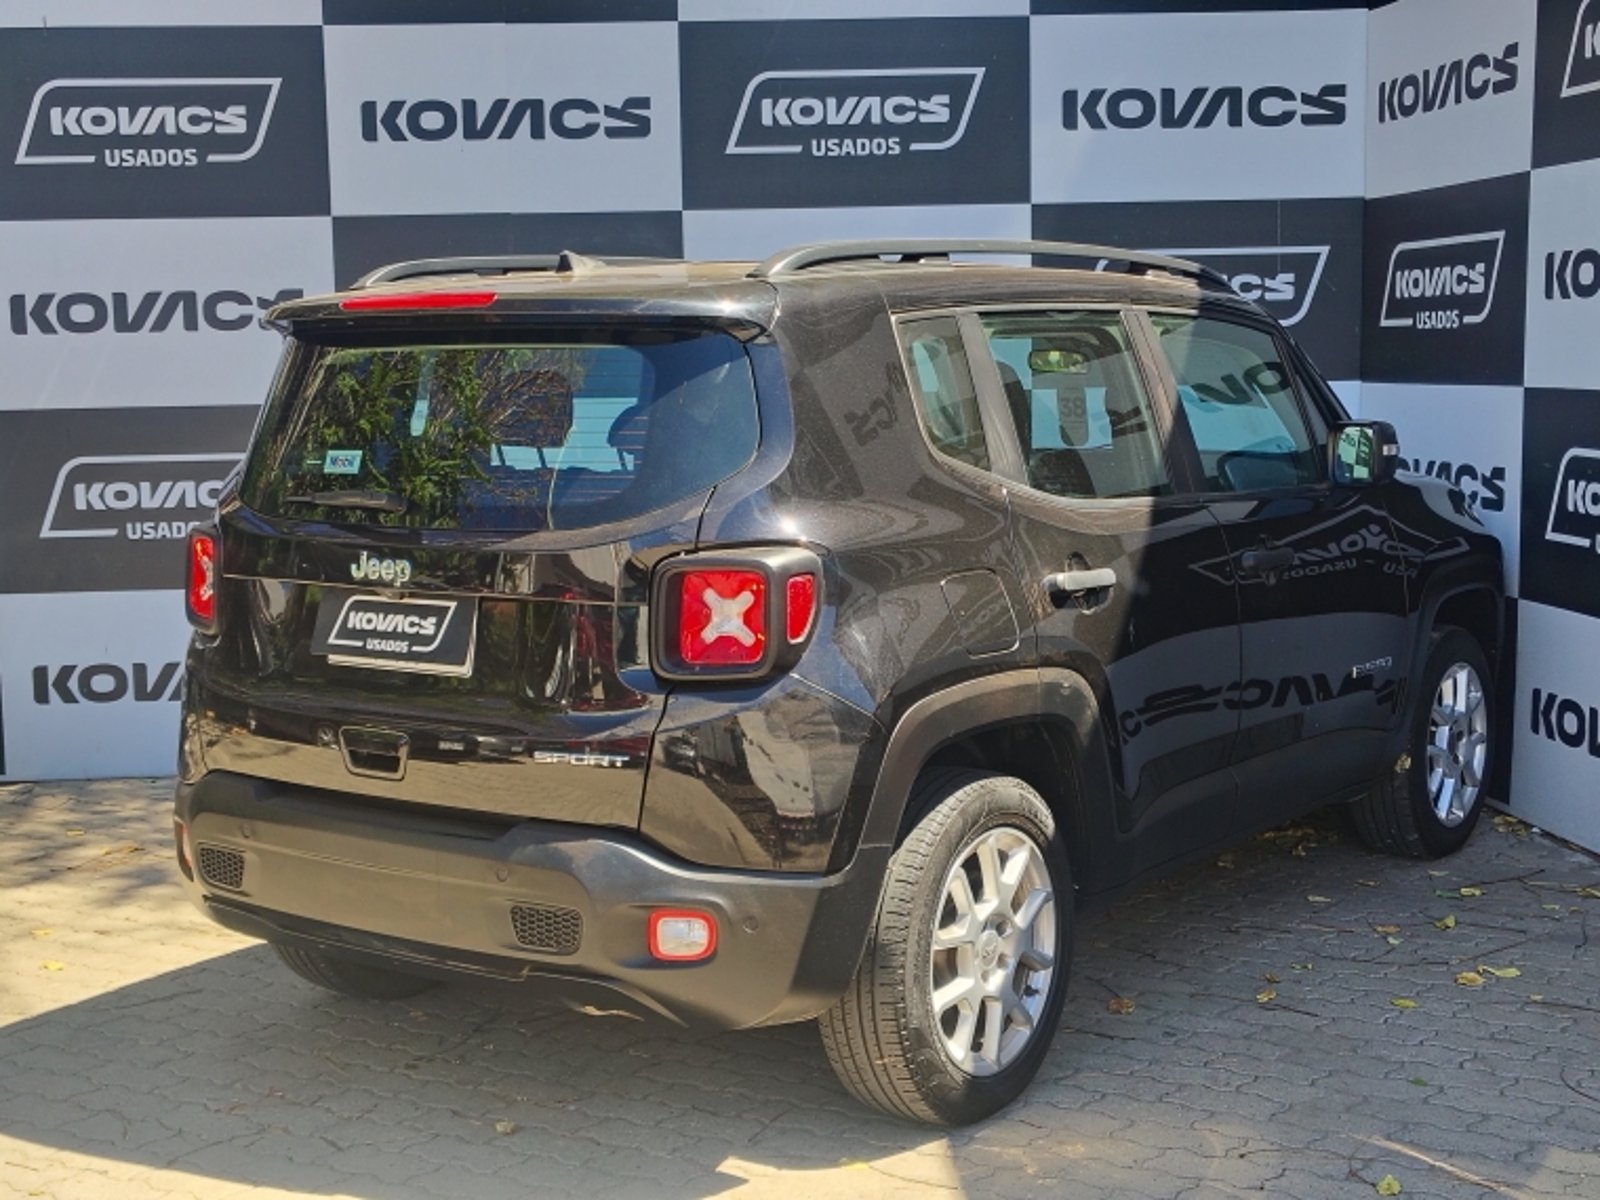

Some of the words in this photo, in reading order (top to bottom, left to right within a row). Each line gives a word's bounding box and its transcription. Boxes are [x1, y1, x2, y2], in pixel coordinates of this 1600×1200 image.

[1378, 41, 1519, 124] KOVACS
[50, 105, 247, 136] KOVACS
[360, 96, 651, 142] KOVACS
[760, 94, 950, 127] KOVACS
[1062, 84, 1347, 130] KOVACS
[104, 148, 199, 167] USADOS
[811, 137, 901, 157] USADOS
[1395, 262, 1486, 299] KOVACS
[1416, 309, 1459, 330] USADOS
[74, 480, 224, 510] KOVAC
[126, 521, 200, 540] USAD
[350, 551, 412, 586] Jeep
[347, 611, 437, 635] KOVACS
[366, 637, 409, 653] USADOS
[533, 750, 631, 768] SPORT
